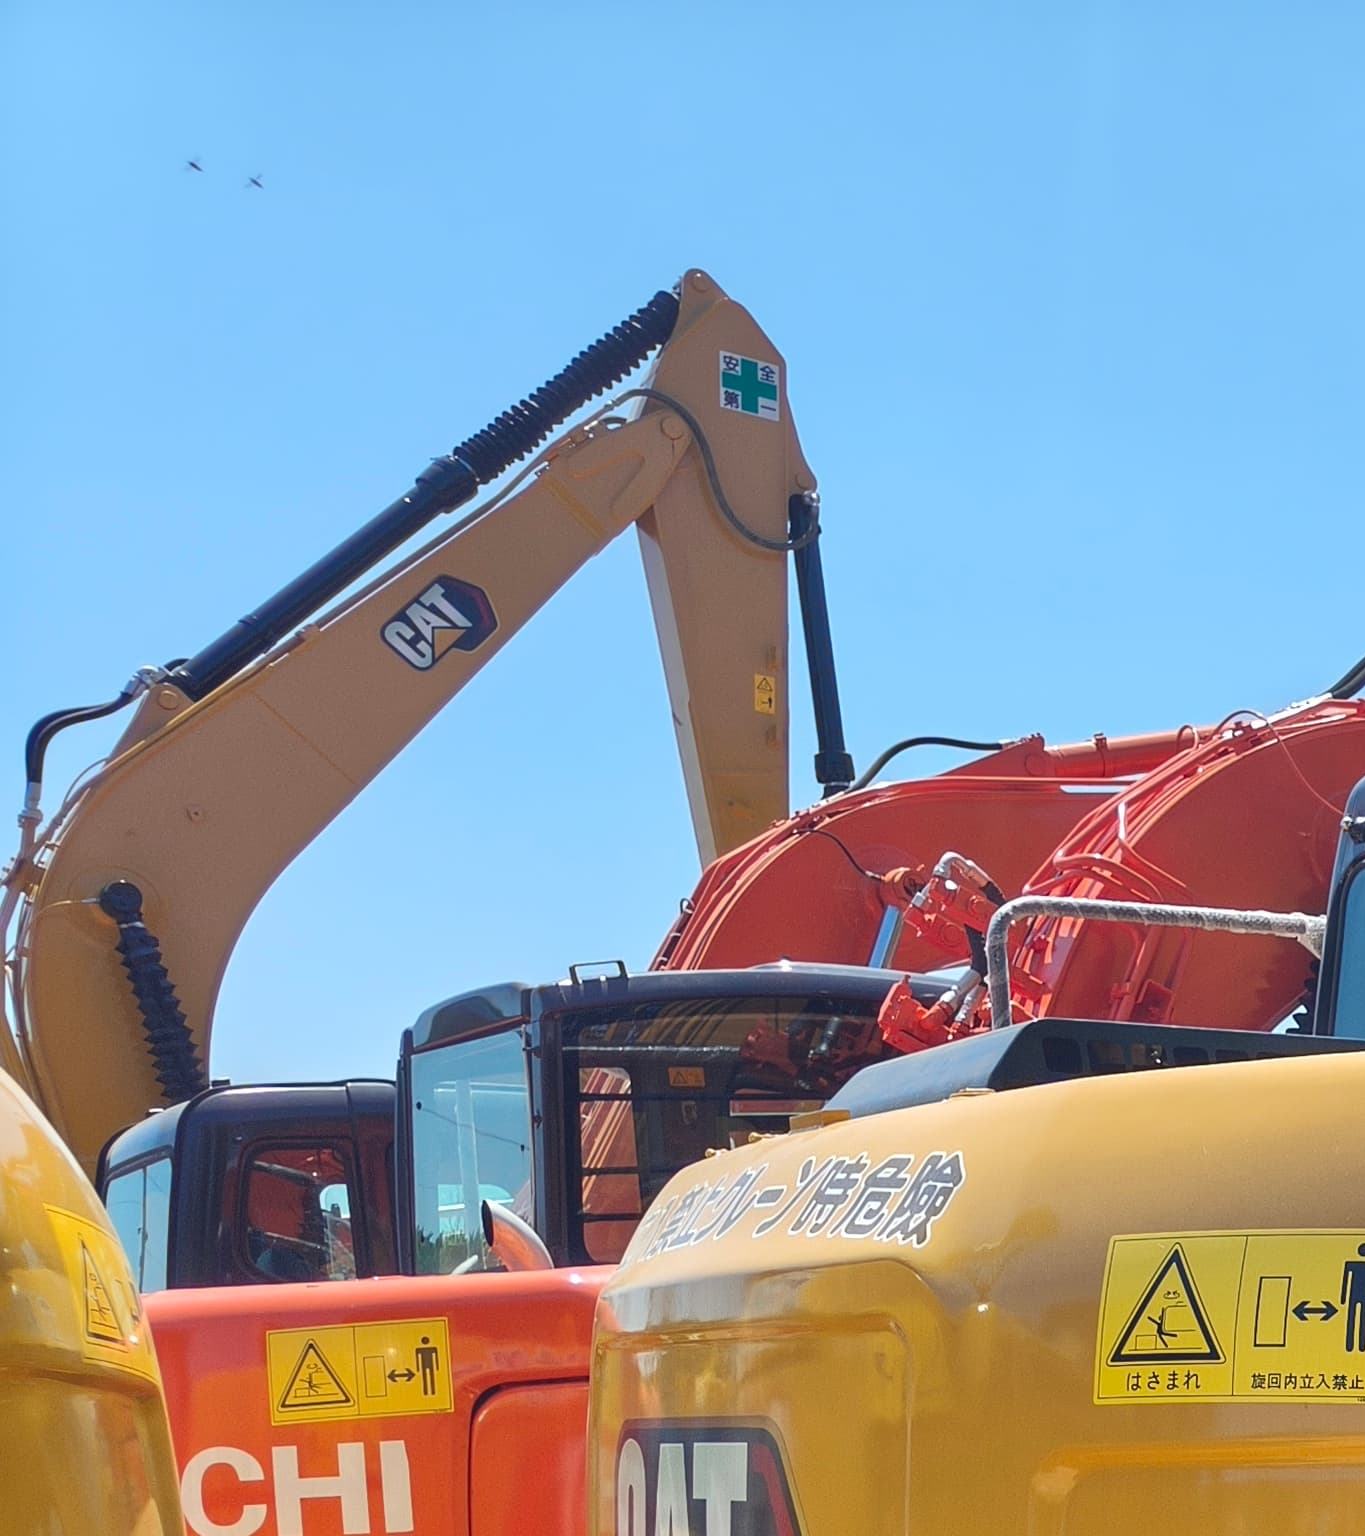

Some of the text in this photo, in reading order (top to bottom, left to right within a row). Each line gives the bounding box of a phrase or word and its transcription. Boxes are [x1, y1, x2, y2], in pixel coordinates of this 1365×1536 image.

[385, 583, 473, 668] CAT
[1126, 1370, 1201, 1391] はさまれ
[1251, 1373, 1365, 1390] 旋回内立入禁止
